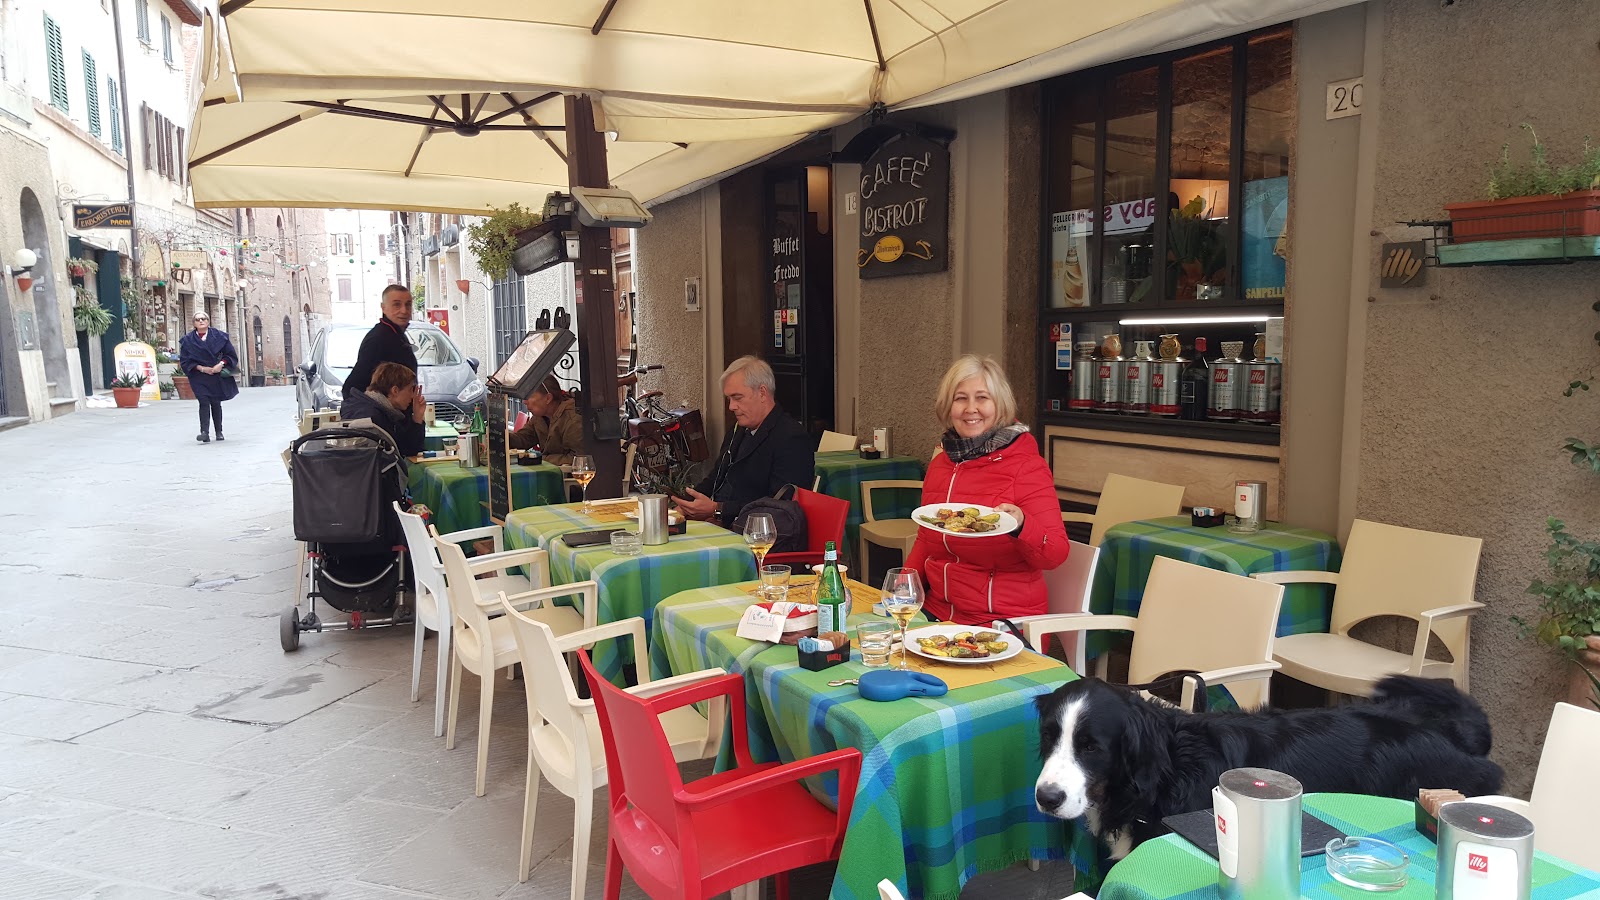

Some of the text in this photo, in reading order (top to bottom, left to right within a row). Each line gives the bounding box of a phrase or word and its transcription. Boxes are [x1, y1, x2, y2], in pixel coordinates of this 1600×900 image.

[1333, 83, 1363, 112] 20
[80, 205, 126, 227] ERBORISTERIA
[862, 197, 928, 237] BISTROT
[772, 236, 800, 256] Buffet
[1382, 248, 1422, 285] illy
[1214, 369, 1228, 382] illy
[1251, 371, 1265, 384] illy
[1469, 856, 1487, 871] illy
